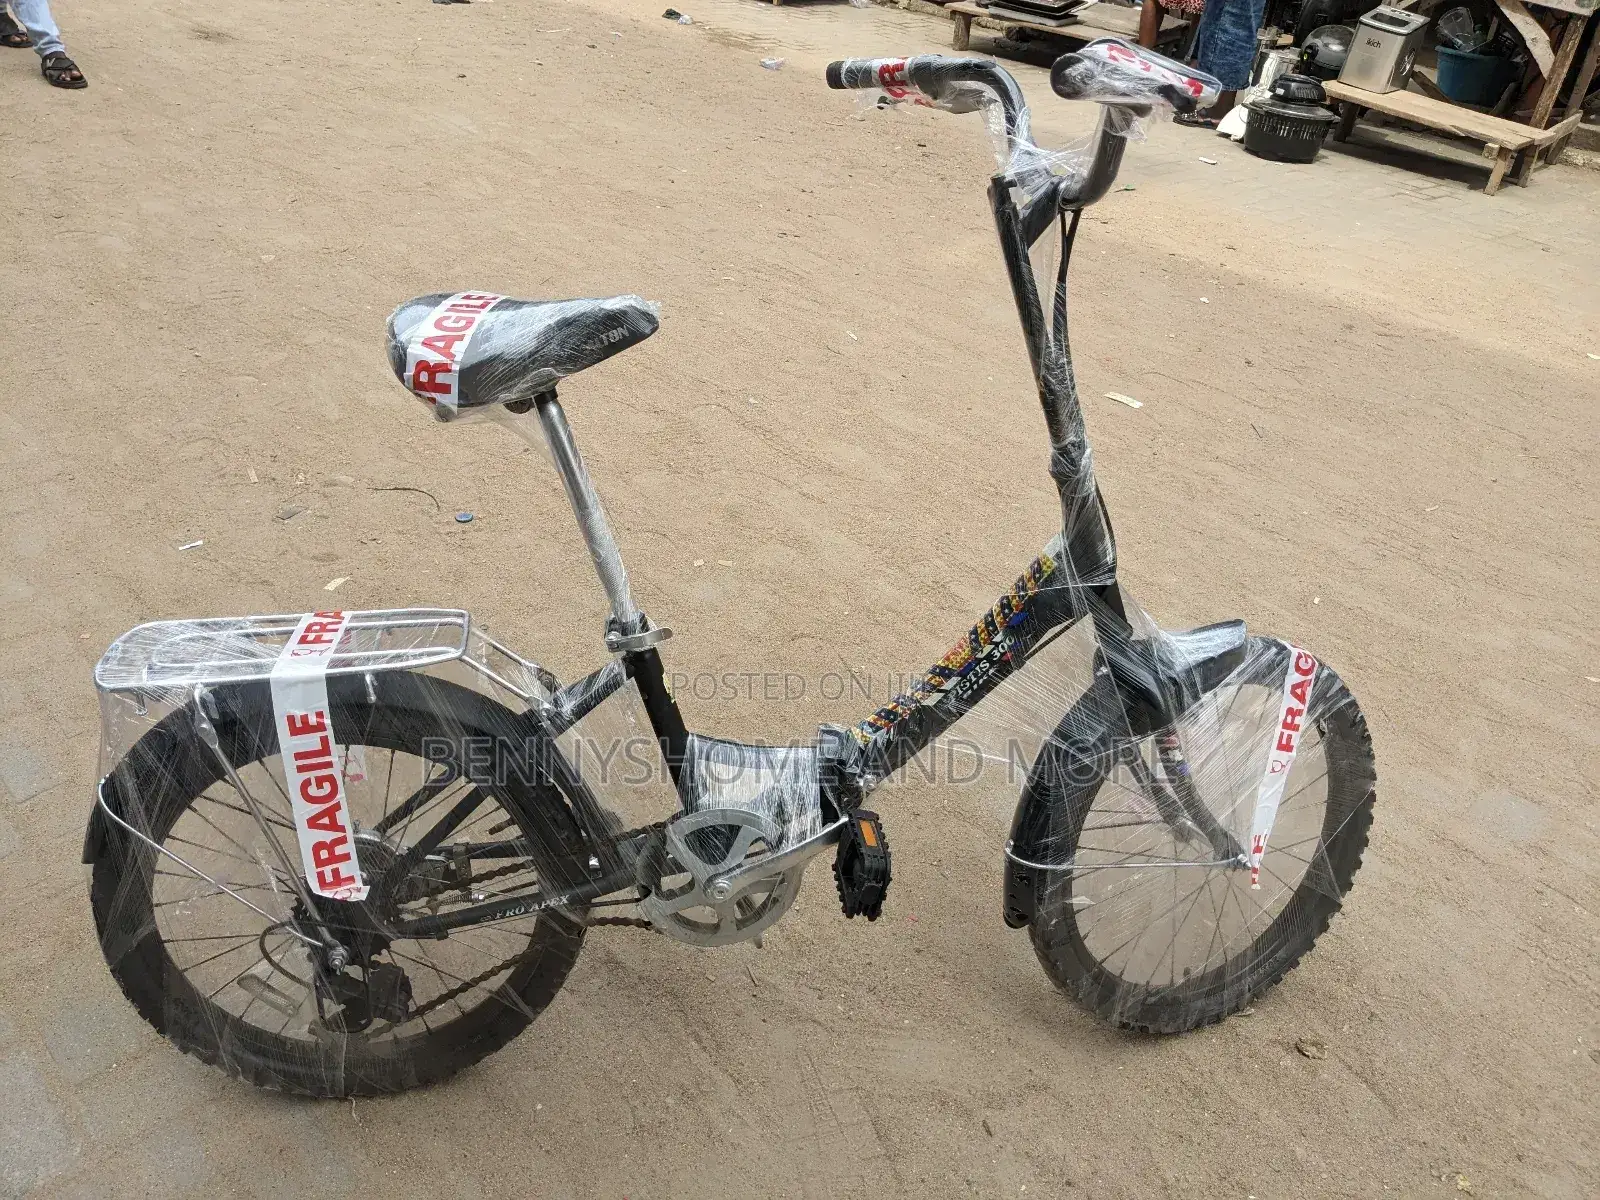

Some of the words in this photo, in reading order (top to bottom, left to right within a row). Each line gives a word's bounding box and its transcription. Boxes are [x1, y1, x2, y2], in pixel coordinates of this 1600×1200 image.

[991, 634, 1015, 661] 300
[286, 710, 356, 892] FRAGILE
[529, 894, 570, 912] APEX
